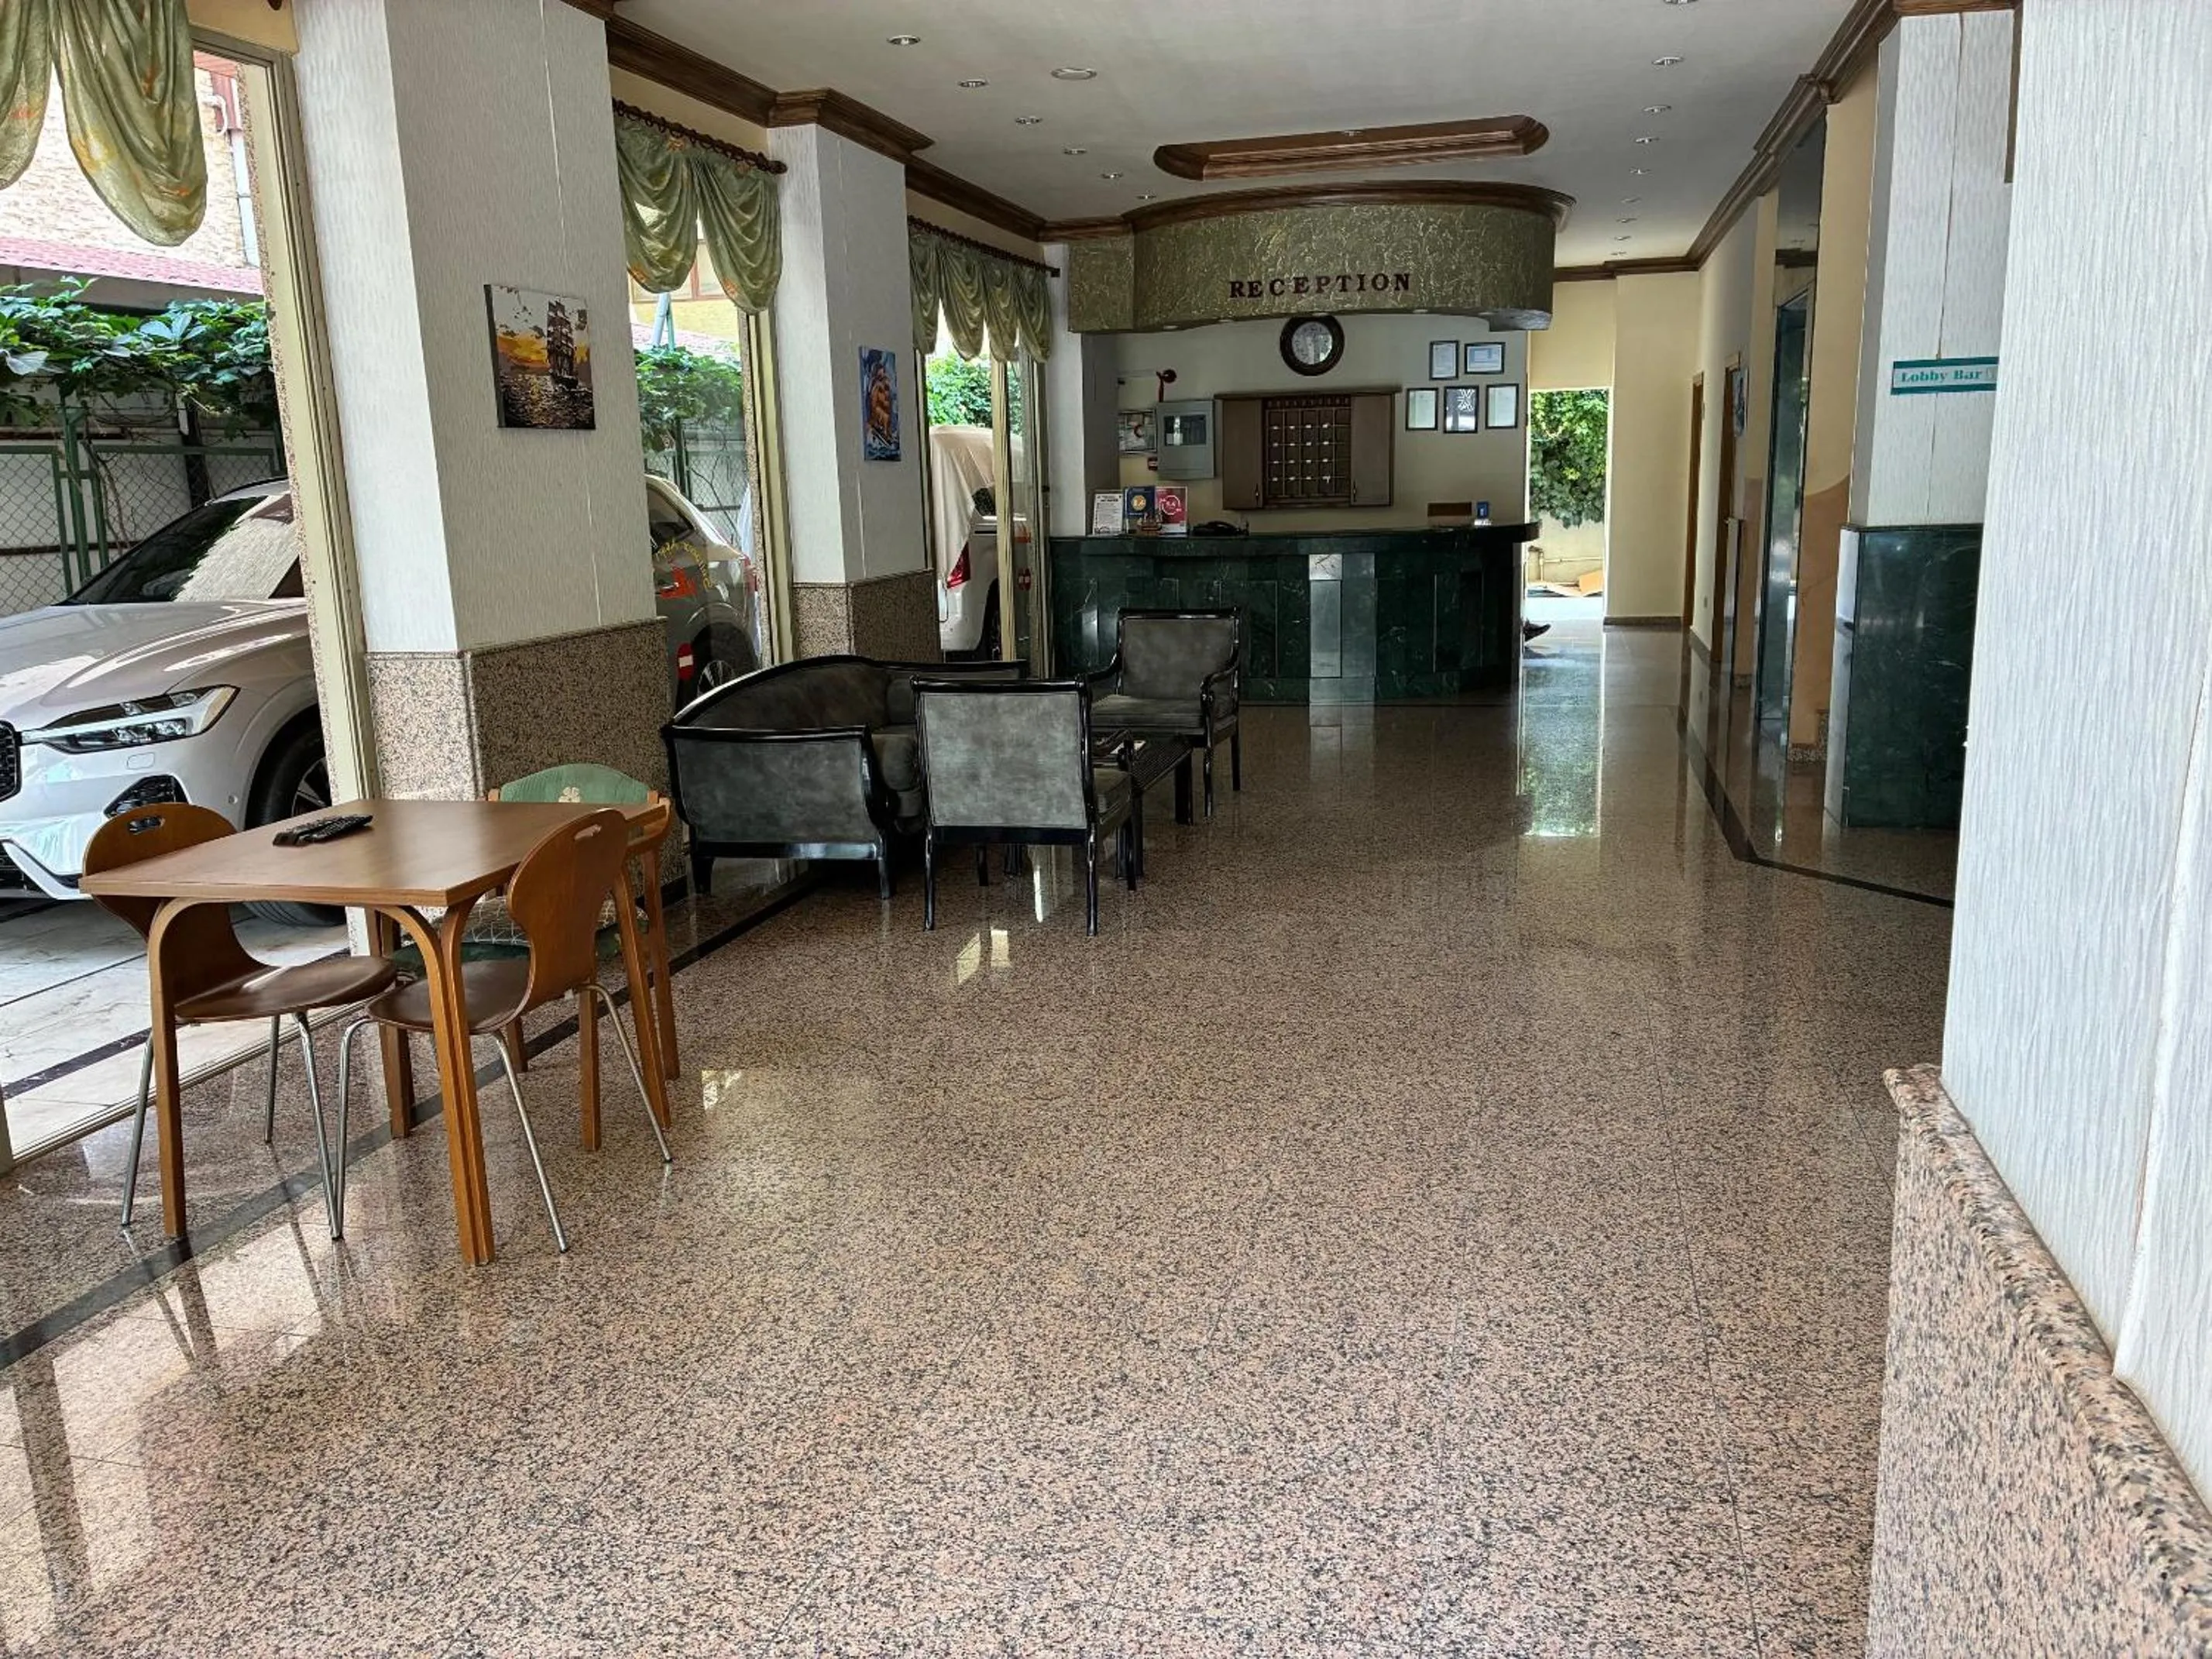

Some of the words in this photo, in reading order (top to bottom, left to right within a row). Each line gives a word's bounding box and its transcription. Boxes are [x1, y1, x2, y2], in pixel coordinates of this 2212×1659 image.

[1229, 273, 1410, 298] RECEPTION
[1901, 371, 1947, 383] Lobby
[1953, 369, 1984, 380] Bar
